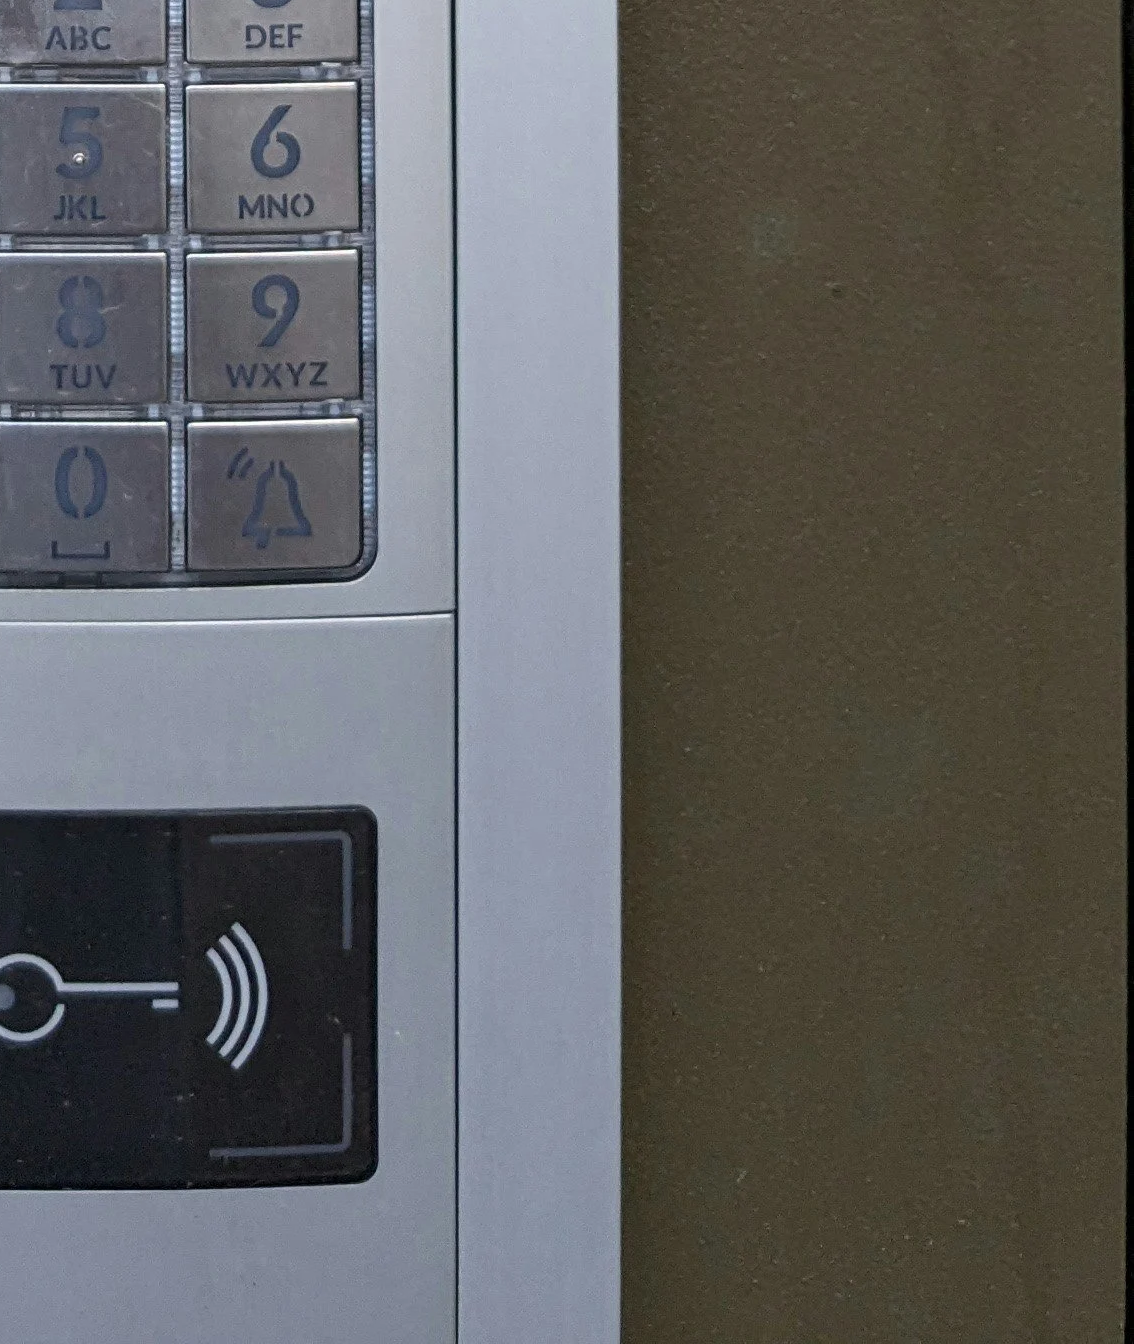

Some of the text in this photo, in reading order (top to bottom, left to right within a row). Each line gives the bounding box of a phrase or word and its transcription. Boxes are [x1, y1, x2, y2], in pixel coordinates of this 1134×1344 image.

[45, 26, 111, 51] ABC
[245, 24, 303, 49] DEF
[56, 106, 103, 180] 5
[250, 105, 301, 179] 6
[54, 196, 106, 221] JKL
[238, 194, 314, 219] MNO
[56, 275, 106, 349] 8
[251, 274, 300, 348] 9
[50, 363, 116, 389] TUV
[225, 362, 328, 388] WXYZ
[55, 446, 108, 520] 0
